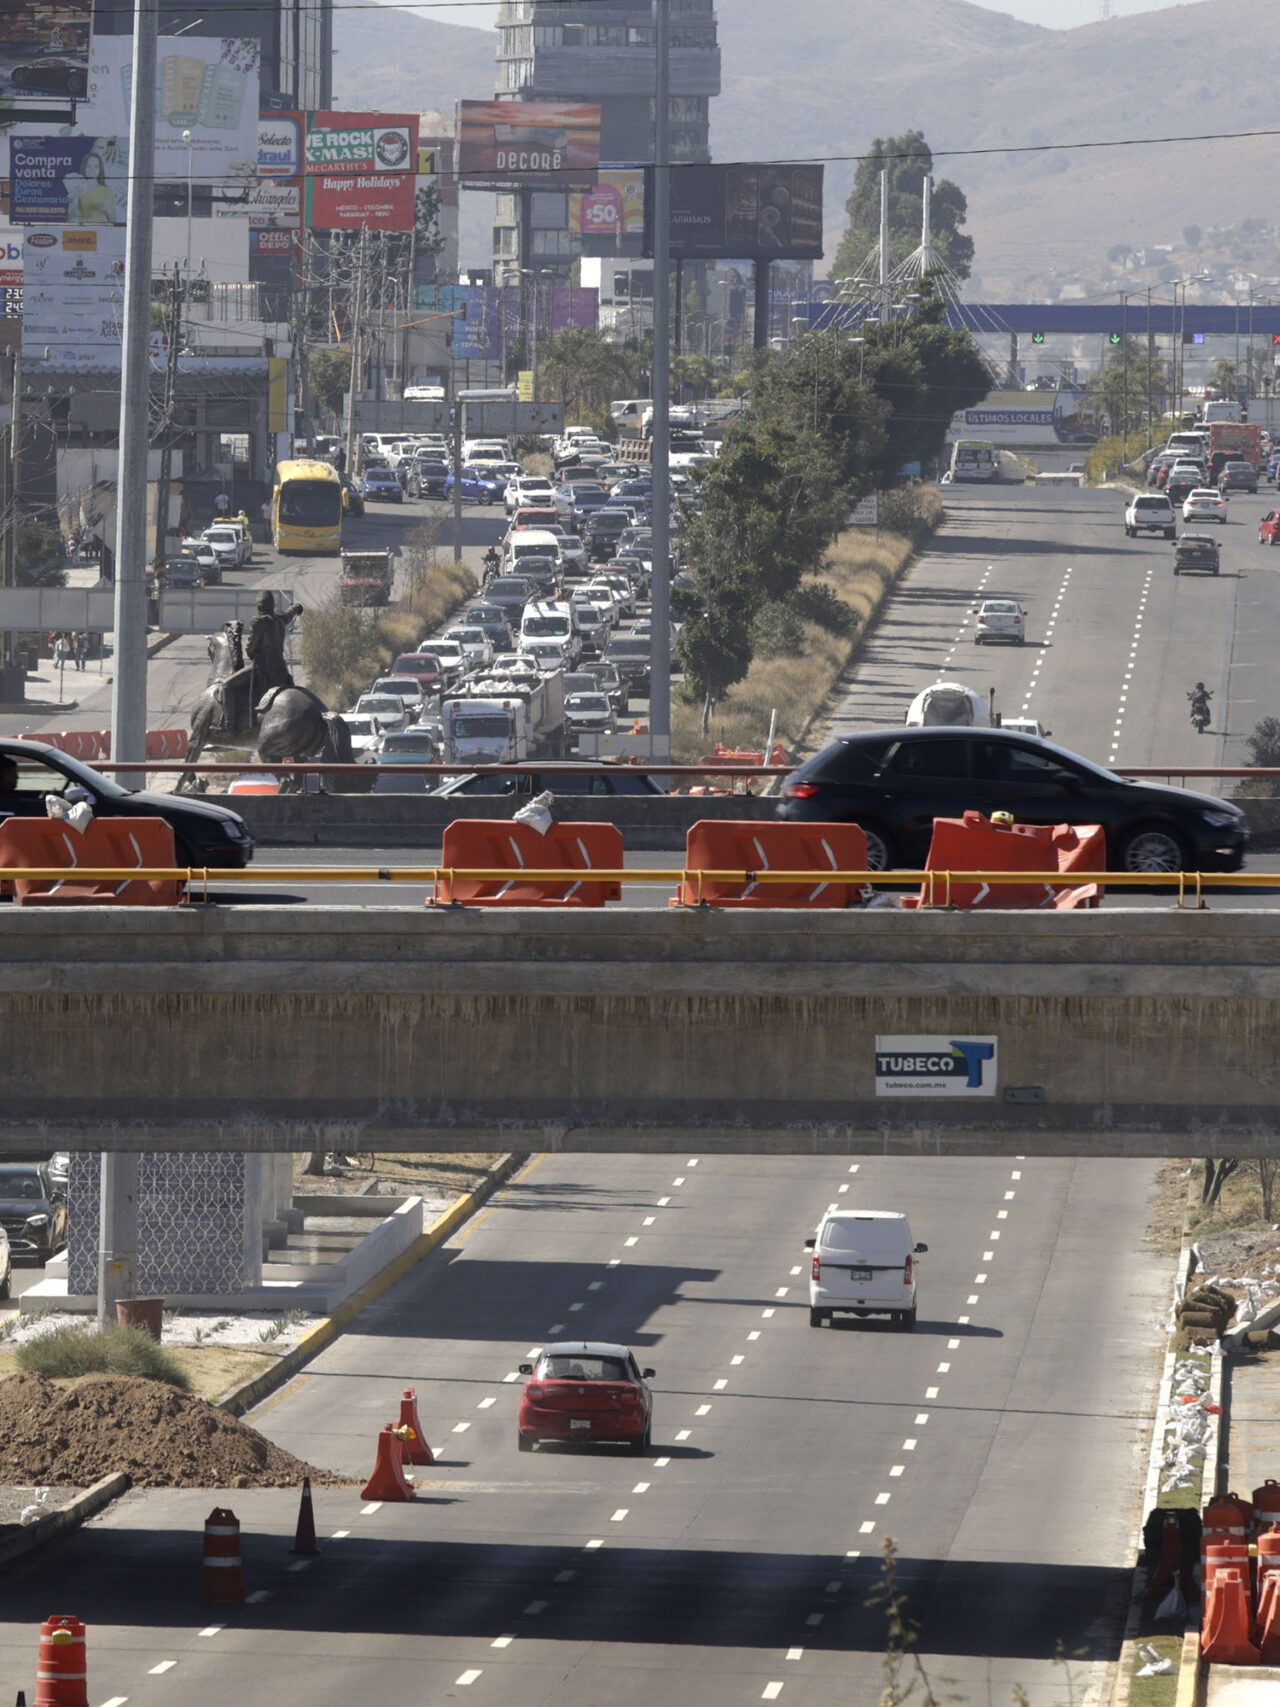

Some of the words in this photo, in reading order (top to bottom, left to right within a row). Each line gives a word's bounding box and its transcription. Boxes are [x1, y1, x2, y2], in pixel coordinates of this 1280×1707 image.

[258, 132, 292, 146] Selecto
[326, 131, 372, 146] ROCK
[305, 146, 373, 161] X-MAS!
[14, 153, 72, 169] Compra
[15, 166, 56, 178] venta
[323, 177, 355, 191] Happy
[357, 175, 401, 189] Holidays
[14, 187, 43, 196] Euros
[585, 203, 617, 224] $50
[259, 231, 290, 242] Offic
[260, 241, 289, 249] DEPO
[1011, 414, 1053, 423] LOCALES
[878, 1057, 954, 1071] TUBECO
[885, 1081, 947, 1089] tubeco.com.mx
